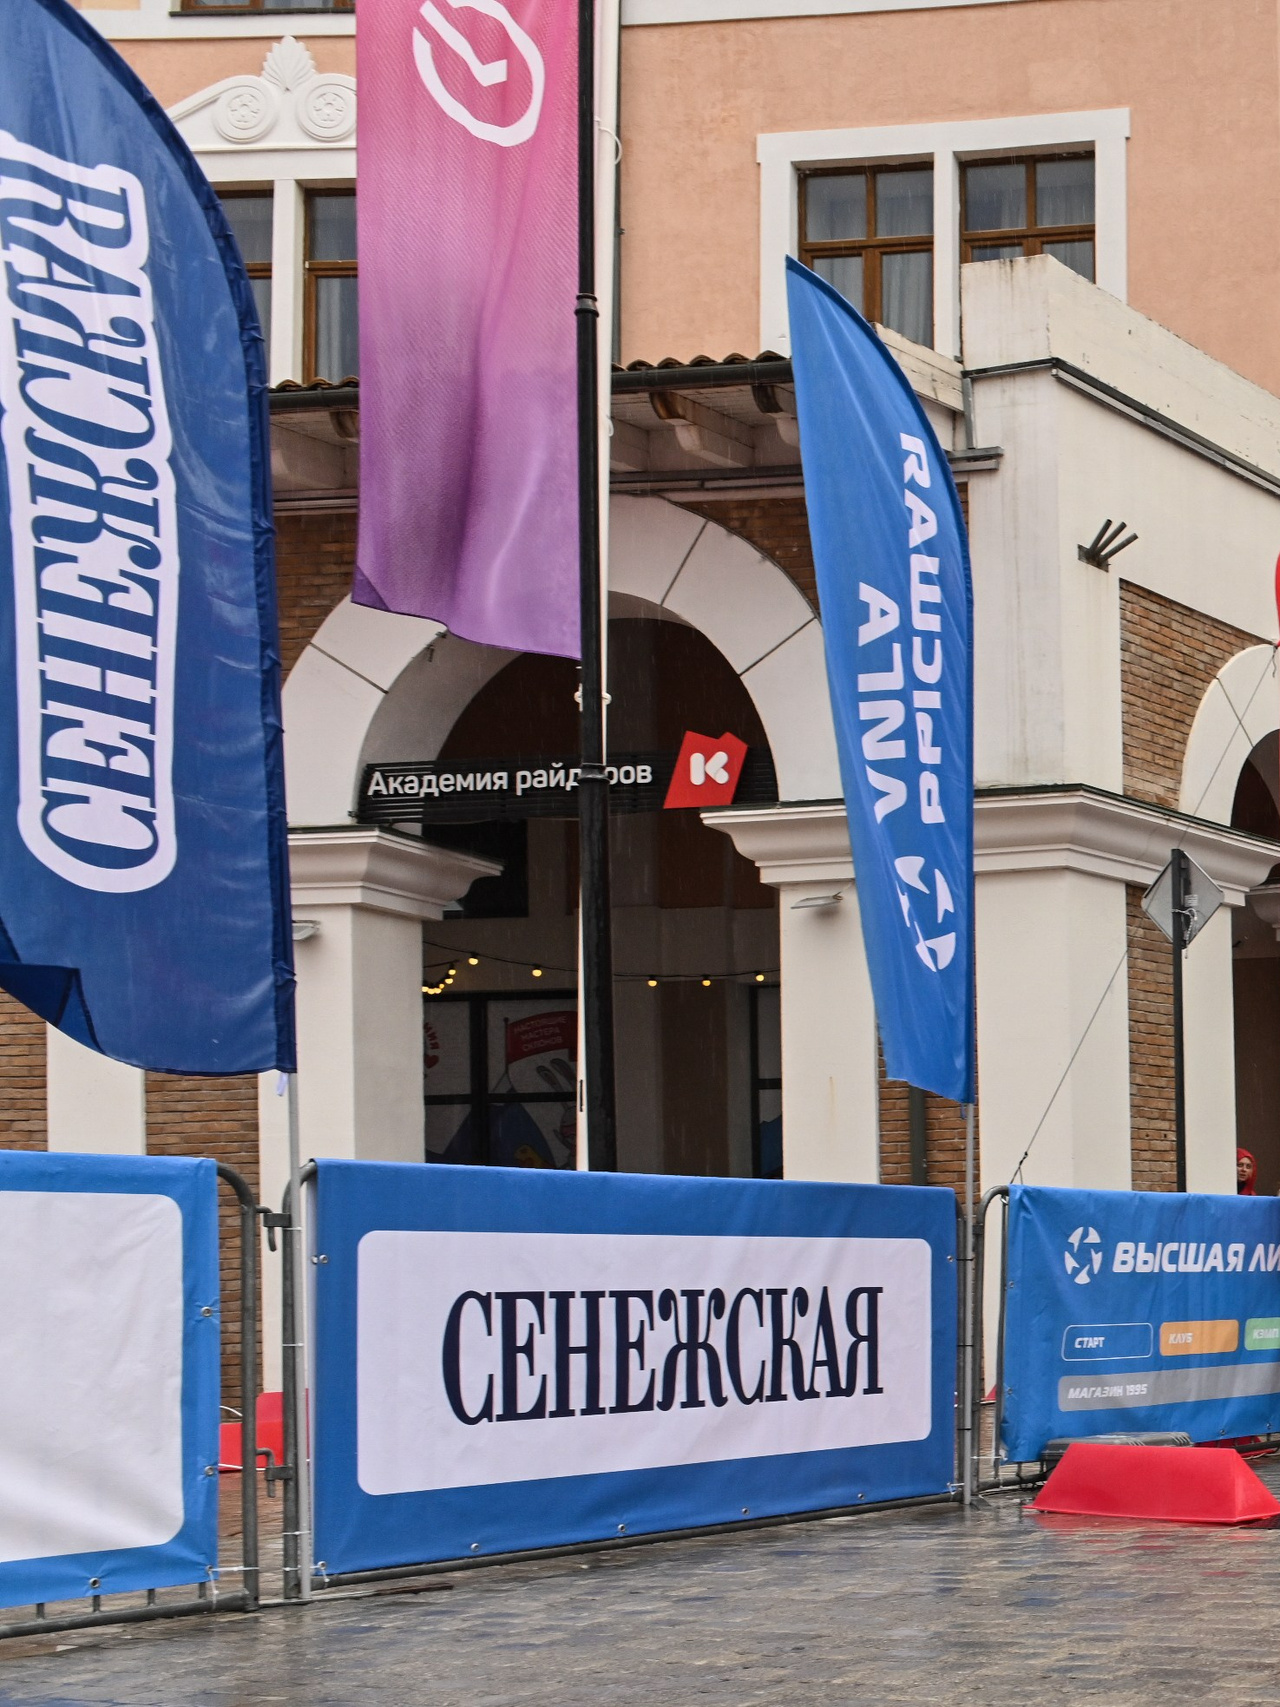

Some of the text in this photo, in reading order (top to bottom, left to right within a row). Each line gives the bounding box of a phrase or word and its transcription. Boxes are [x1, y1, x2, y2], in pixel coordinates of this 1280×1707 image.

[367, 771, 508, 797] Академия
[1112, 1241, 1246, 1273] ВЫСШАЯ
[1168, 1332, 1193, 1345] КЛУБ
[1252, 1327, 1280, 1340] КЭМП
[1074, 1336, 1105, 1349] СТАРТ
[441, 1285, 884, 1426] СЕНЕЖСКАЯ
[1067, 1383, 1148, 1399] МАГАЗИН 1995
